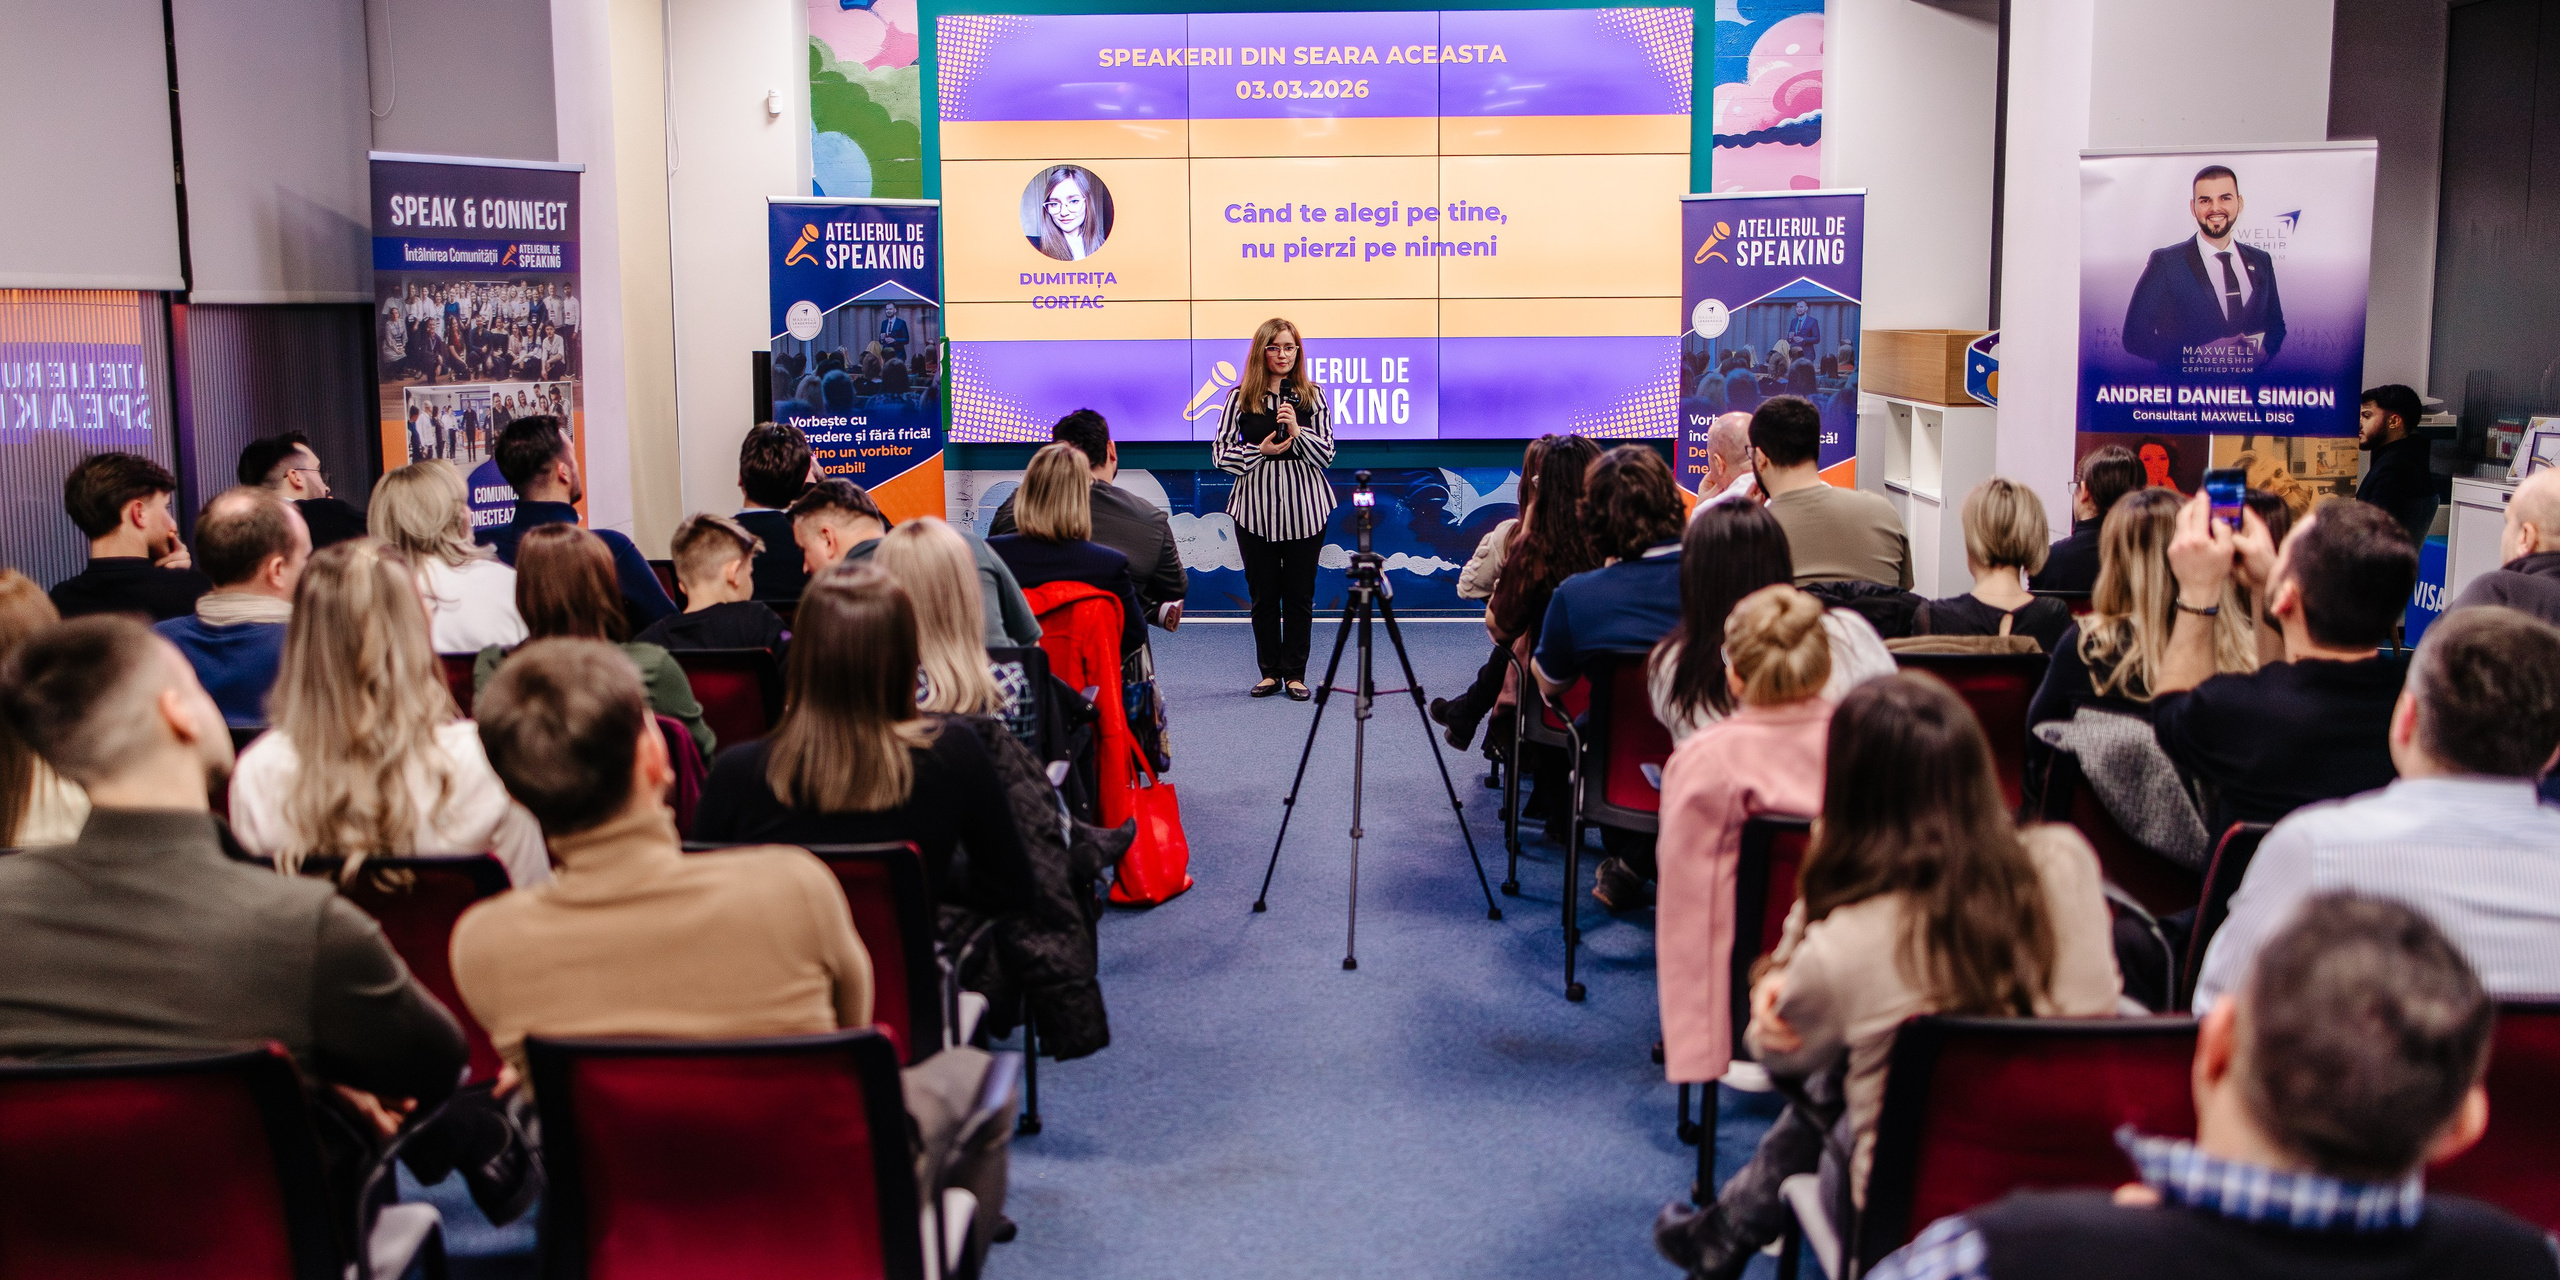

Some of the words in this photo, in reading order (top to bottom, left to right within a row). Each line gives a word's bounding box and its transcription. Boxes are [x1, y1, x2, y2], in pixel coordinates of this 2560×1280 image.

[1098, 47, 1233, 67] SPEAKERII
[1241, 47, 1286, 66] DIN
[1293, 46, 1380, 66] SEARA
[1385, 44, 1507, 64] ACEASTA
[1236, 79, 1369, 100] 03.03.2026
[391, 195, 458, 227] SPEAK
[463, 198, 476, 228] &
[482, 199, 568, 231] CONNECT
[1224, 203, 1292, 224] Când
[1299, 206, 1327, 223] te
[1334, 201, 1399, 228] alegi
[1407, 206, 1440, 228] pe
[1448, 201, 1508, 225] tine,
[825, 222, 902, 242] ATELIERUL
[906, 223, 924, 242] DE
[1737, 217, 1820, 238] ATELIERUL
[1826, 216, 1846, 236] DE
[2231, 228, 2287, 239] WELL
[404, 243, 448, 262] Întâlnirea
[449, 247, 498, 265] Comunității
[519, 244, 550, 255] ATELIERUL
[551, 245, 561, 255] DE
[825, 243, 925, 270] SPEAKING
[1241, 240, 1275, 259] nu
[1283, 235, 1357, 263] pierzi
[1364, 239, 1397, 263] pe
[1405, 235, 1498, 258] nimeni
[1736, 238, 1845, 267] SPEAKING
[519, 255, 562, 269] SPEAKING
[1019, 272, 1117, 288] DUMITRIȚA
[1032, 295, 1105, 310] CORTAC
[2182, 346, 2254, 356] MAXWELL
[1306, 357, 1373, 384] IERUL
[1381, 357, 1410, 383] DE
[2096, 387, 2172, 403] ANDREI
[2178, 388, 2253, 405] DANIEL
[2257, 389, 2335, 406] SIMION
[1333, 388, 1410, 425] KING
[789, 415, 848, 430] Vorbește
[850, 416, 867, 425] cu
[2132, 410, 2198, 422] Consultant
[2201, 411, 2261, 422] MAXWELL
[2265, 411, 2295, 423] DISC
[804, 431, 852, 443] credere
[855, 429, 866, 445] și
[869, 429, 895, 442] fără
[898, 428, 931, 440] frică!
[839, 449, 857, 458] un
[860, 445, 913, 457] vorbitor
[821, 461, 866, 474] orabil!
[474, 485, 519, 504] COMUNIC
[2414, 581, 2446, 612] VISA
